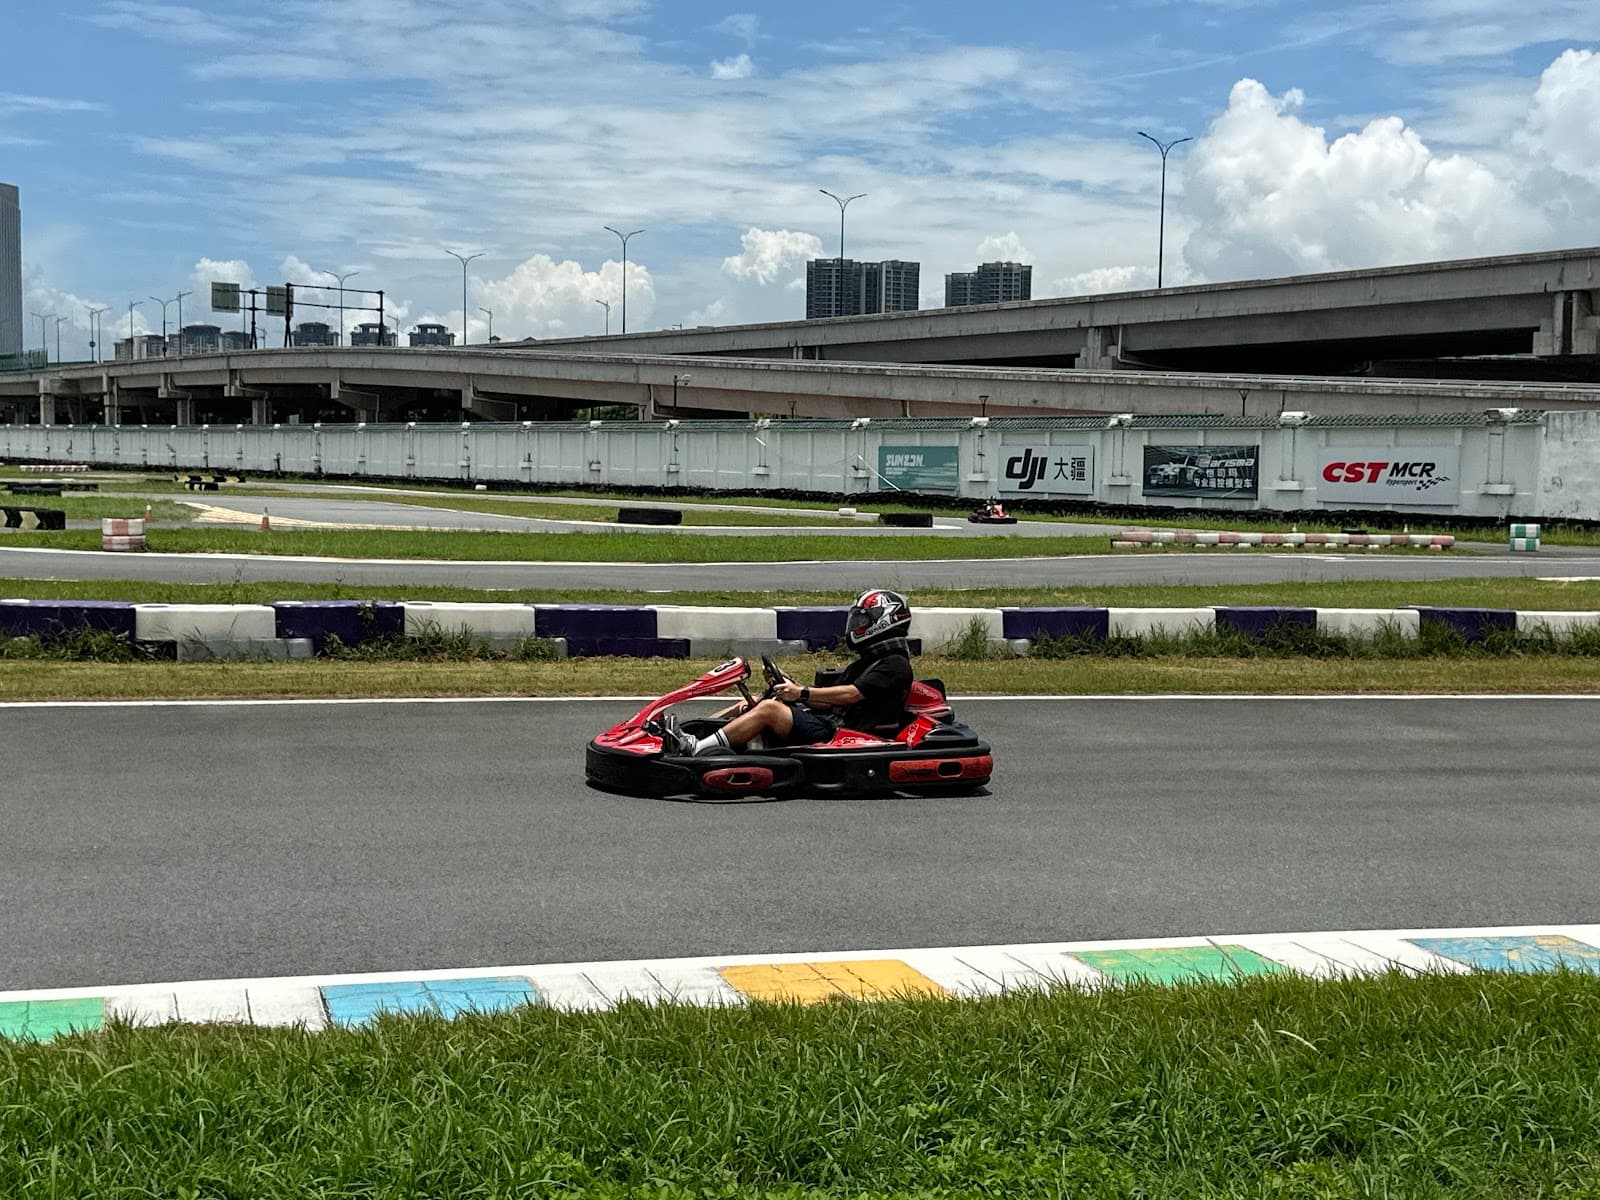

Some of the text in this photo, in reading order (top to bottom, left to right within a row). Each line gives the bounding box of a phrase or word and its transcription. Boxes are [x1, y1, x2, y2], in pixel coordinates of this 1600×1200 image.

[1053, 457, 1087, 481] 大疆
[1322, 462, 1436, 483] CST MCR
